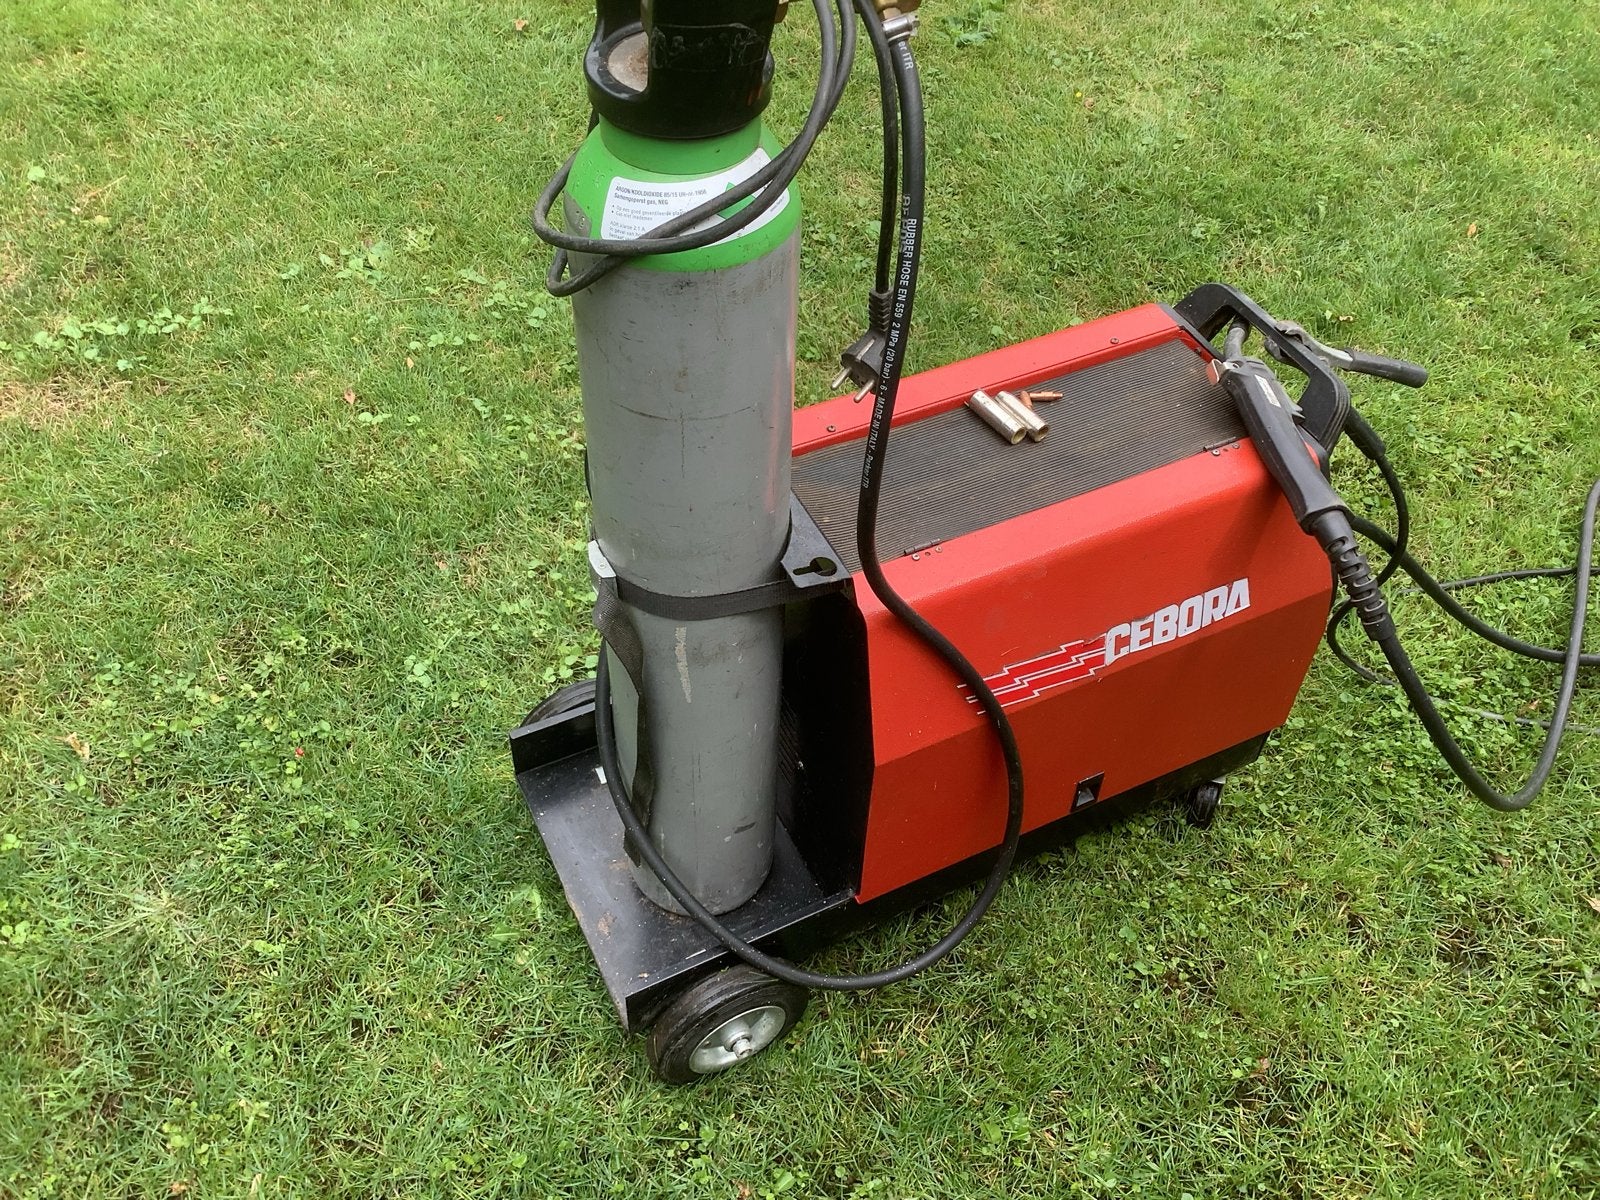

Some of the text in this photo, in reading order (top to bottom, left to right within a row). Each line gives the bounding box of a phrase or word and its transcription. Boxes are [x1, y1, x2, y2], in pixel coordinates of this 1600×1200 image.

[902, 52, 914, 70] ITR
[903, 218, 917, 258] RUBBER
[899, 260, 912, 286] HOSE
[897, 288, 907, 301] EN
[894, 302, 905, 318] 559
[888, 329, 899, 347] MPa
[885, 348, 896, 362] (20
[881, 362, 893, 379] bar)
[874, 396, 886, 420] MADE
[872, 419, 880, 430] IN
[868, 428, 878, 450] ITALY
[1104, 577, 1251, 667] CEBORA
